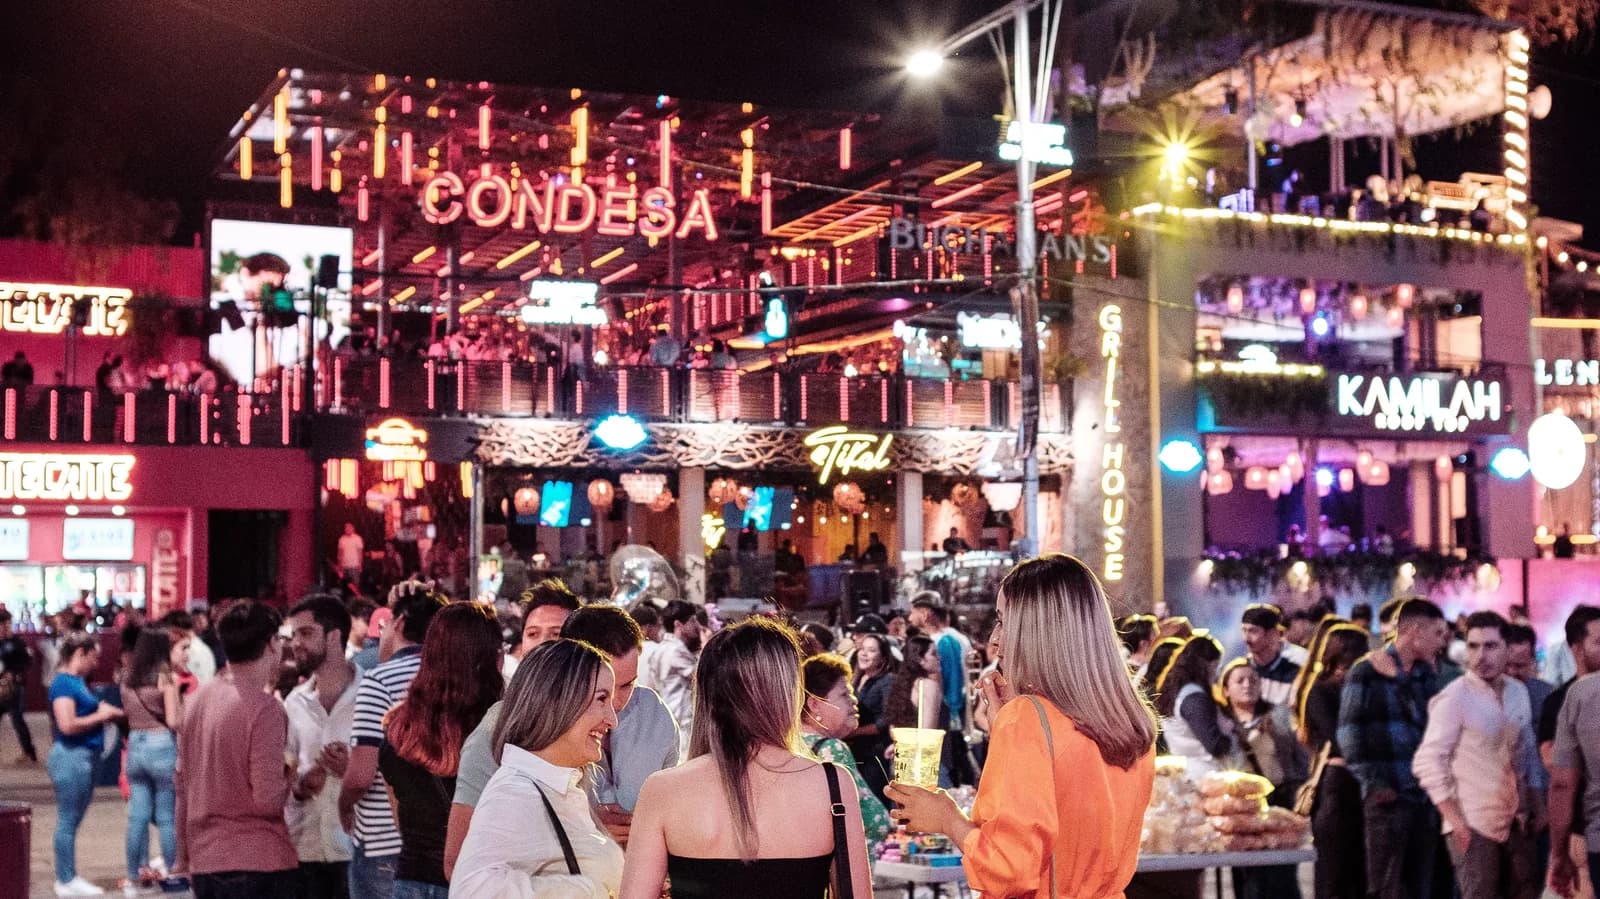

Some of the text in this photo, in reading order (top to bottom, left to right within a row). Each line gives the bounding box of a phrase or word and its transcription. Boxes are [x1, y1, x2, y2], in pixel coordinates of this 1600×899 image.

[423, 171, 718, 241] CONDESA
[1338, 374, 1501, 421] KAMILAH
[1098, 303, 1126, 581] GRILL HOUSE
[0, 452, 136, 500] TECATE
